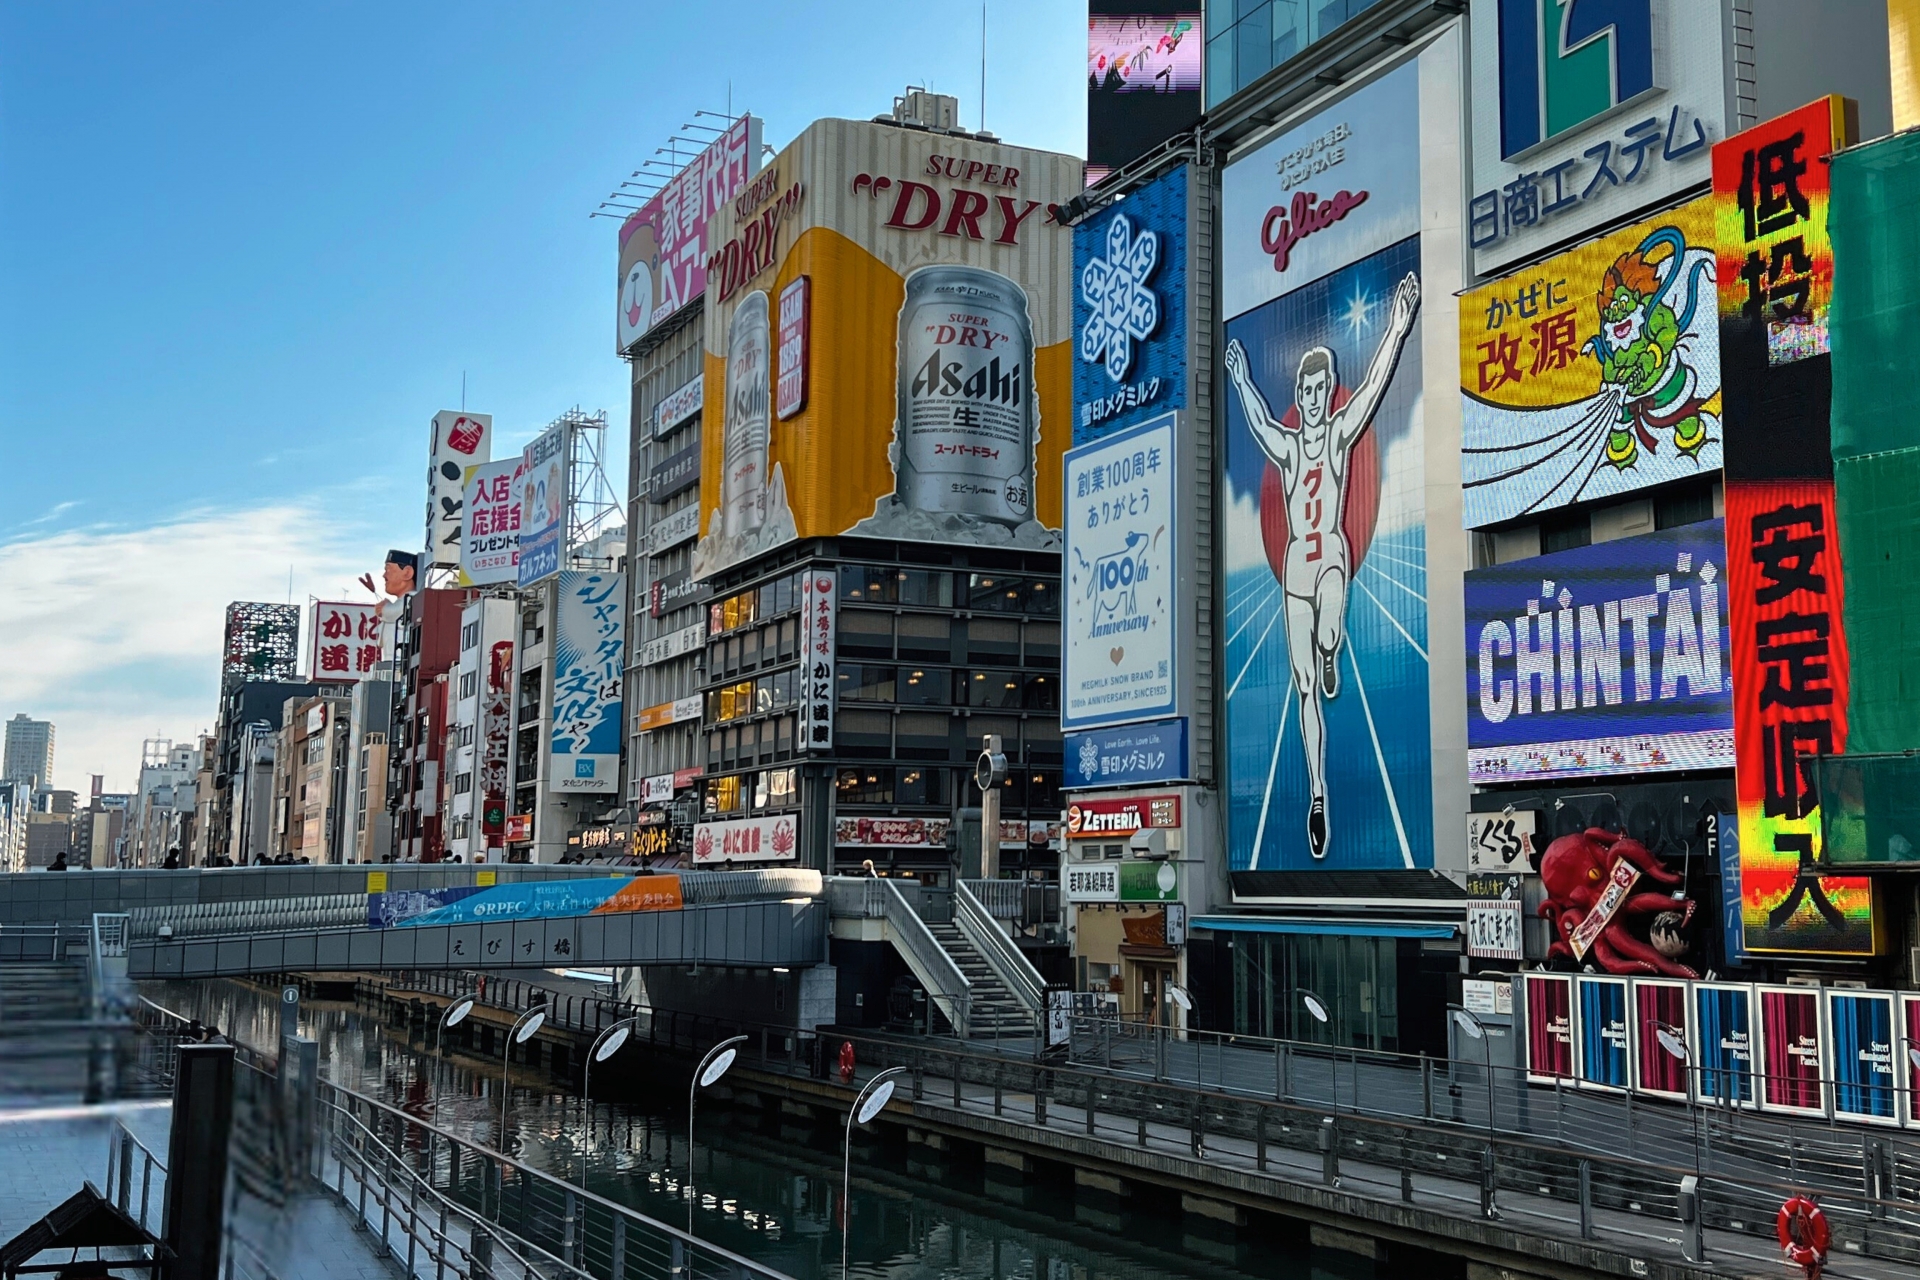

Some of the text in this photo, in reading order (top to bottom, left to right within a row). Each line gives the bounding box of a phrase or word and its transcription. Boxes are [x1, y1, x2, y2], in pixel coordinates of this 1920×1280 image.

[661, 120, 747, 253] 家事代行
[926, 154, 1020, 187] SUPER
[1469, 105, 1706, 249] 日商エステム
[735, 168, 777, 223] SUPER
[780, 288, 803, 332] ASAHI
[948, 313, 988, 327] SUPER
[1485, 278, 1568, 331] かぜに
[779, 334, 801, 376] 1889
[1476, 307, 1579, 393] 改源
[911, 348, 1020, 407] Asahi
[953, 407, 981, 428] 生
[1081, 376, 1160, 427] 雪印メグミルク
[935, 444, 999, 460] スーパードライ
[472, 474, 510, 506] 入店
[1077, 446, 1161, 498] 創業100周年
[1006, 485, 1027, 508] お酒
[1088, 488, 1150, 528] ありがとう
[1303, 461, 1323, 563] グリコ
[520, 544, 557, 582] ガルフネット
[1100, 556, 1150, 592] 100th
[322, 611, 381, 640] かに
[1088, 614, 1149, 639] Anniversary
[1479, 555, 1722, 723] CHINTAI
[1110, 674, 1129, 685] SNOW
[1131, 670, 1153, 683] BRAND
[813, 661, 831, 742] かに道楽
[481, 690, 510, 792] 大阪王将
[578, 764, 592, 773] BX
[1101, 751, 1165, 776] 雪印メグミルク
[1083, 810, 1142, 831] ZETTERIA
[723, 826, 760, 854] かに道楽
[1479, 819, 1522, 864] くくる
[453, 938, 571, 956] えびす橋
[1871, 1040, 1889, 1052] Street
